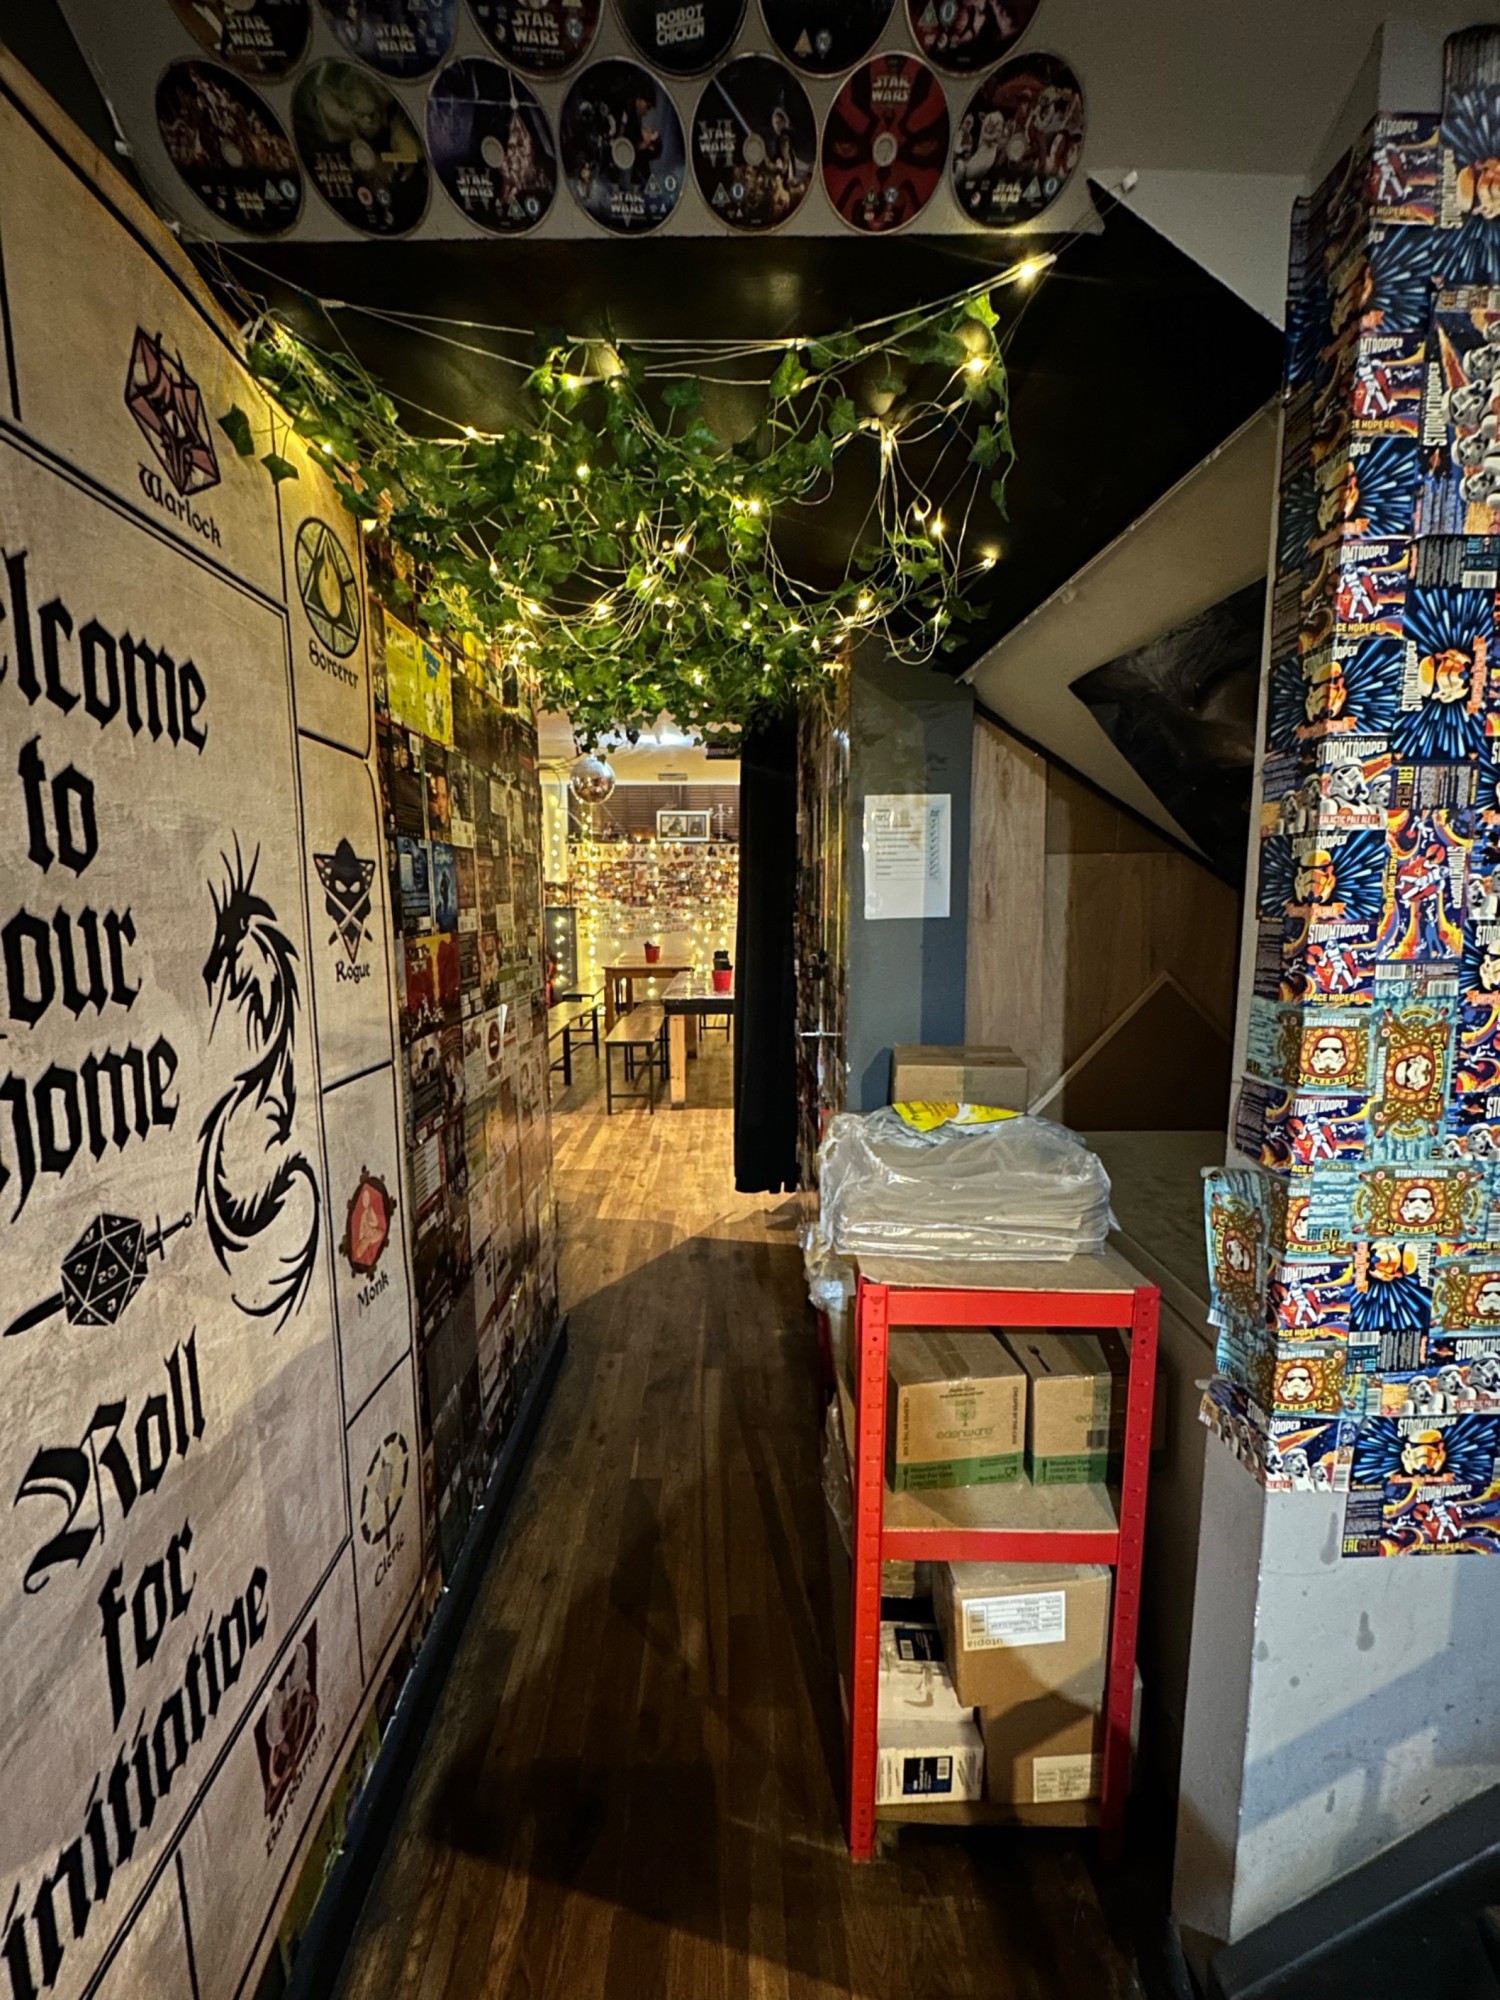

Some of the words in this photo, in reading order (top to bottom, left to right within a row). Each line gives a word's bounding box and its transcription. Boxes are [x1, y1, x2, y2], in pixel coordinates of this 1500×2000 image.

[225, 14, 270, 32] STAR
[511, 10, 558, 28] STAR
[656, 4, 701, 32] ROBOT
[228, 31, 274, 48] WARS
[375, 23, 414, 38] STAR
[513, 27, 560, 46] WARS
[656, 22, 705, 47] CHICKEN
[377, 38, 417, 53] WARS
[872, 75, 910, 88] STAR
[872, 89, 910, 102] WARS
[611, 203, 645, 214] WARS
[1423, 362, 1448, 447] STORMTROOPER
[1362, 419, 1396, 430] HOPERA
[138, 463, 222, 548] Warlock
[1348, 623, 1380, 632] HOPERA
[0, 547, 208, 755] lcome
[308, 640, 359, 690] Sorcerer
[1401, 640, 1423, 712] STORMTROOPER
[1317, 740, 1388, 768] STORMTROOPER
[17, 735, 99, 878] to
[1319, 815, 1346, 825] GALACTIC
[1346, 815, 1361, 825] PALE
[1361, 815, 1373, 824] ALE
[1292, 834, 1348, 859] STORMTROOPER
[1447, 846, 1466, 909] STORMTROOPER
[1385, 874, 1396, 909] HOPERA
[1307, 923, 1369, 945] STORMTROOPER
[0, 904, 142, 1031] our
[336, 959, 371, 984] Rogue
[1304, 993, 1328, 1002] SPACE
[1328, 993, 1361, 1002] HOPERA
[1305, 1017, 1360, 1028] STORMTROOPER
[1290, 1099, 1348, 1116] STORMTROOPER
[1394, 1169, 1449, 1178] STORMTROOPER
[1468, 1242, 1492, 1250] SPACE
[97, 1263, 119, 1285] 20
[1276, 1266, 1330, 1284] STORMTROOPER
[356, 1271, 390, 1319] Monk
[1294, 1328, 1325, 1337] HOPERA
[936, 1424, 993, 1440] edenware
[1397, 1417, 1458, 1437] STORMTROOPER
[13, 1324, 206, 1594] Roll
[1416, 1484, 1472, 1503] STORMTROOPER
[374, 1531, 406, 1588] Cleric
[97, 1517, 197, 1734] for
[967, 1638, 1004, 1648] utopia
[265, 1722, 326, 1859] Barbarian
